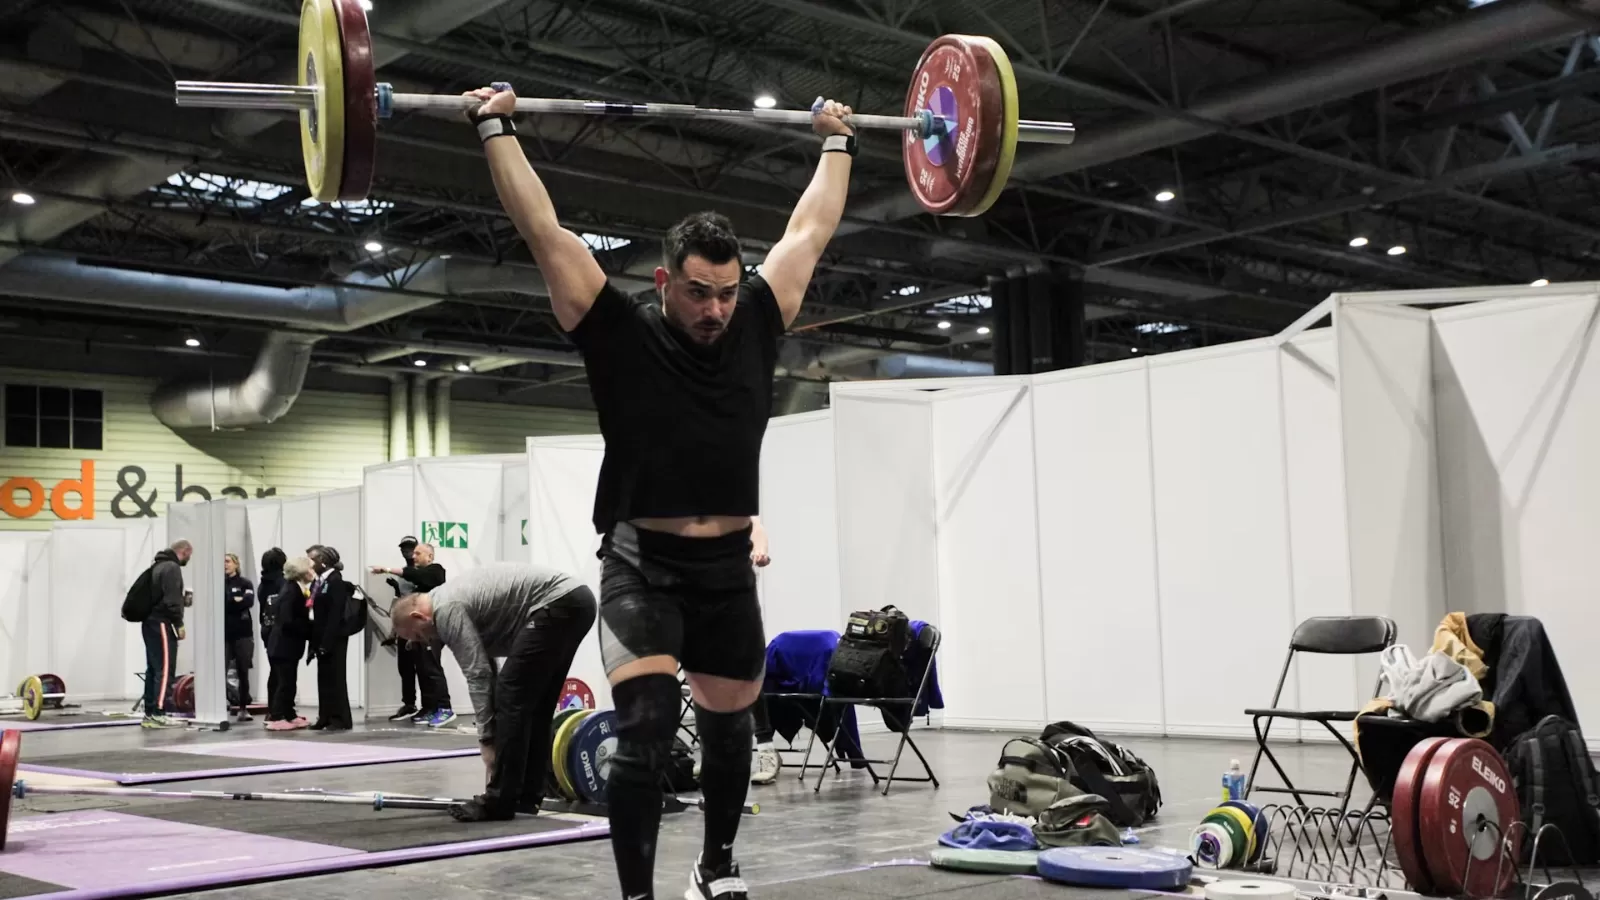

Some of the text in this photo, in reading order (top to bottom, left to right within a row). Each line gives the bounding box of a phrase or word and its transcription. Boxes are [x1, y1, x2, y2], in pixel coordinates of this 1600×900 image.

[953, 64, 961, 82] 25
[908, 71, 930, 144] EIKO
[111, 465, 157, 519] &
[600, 722, 608, 735] 20
[1471, 756, 1506, 794] ELEIKO
[1448, 792, 1460, 809] 25
